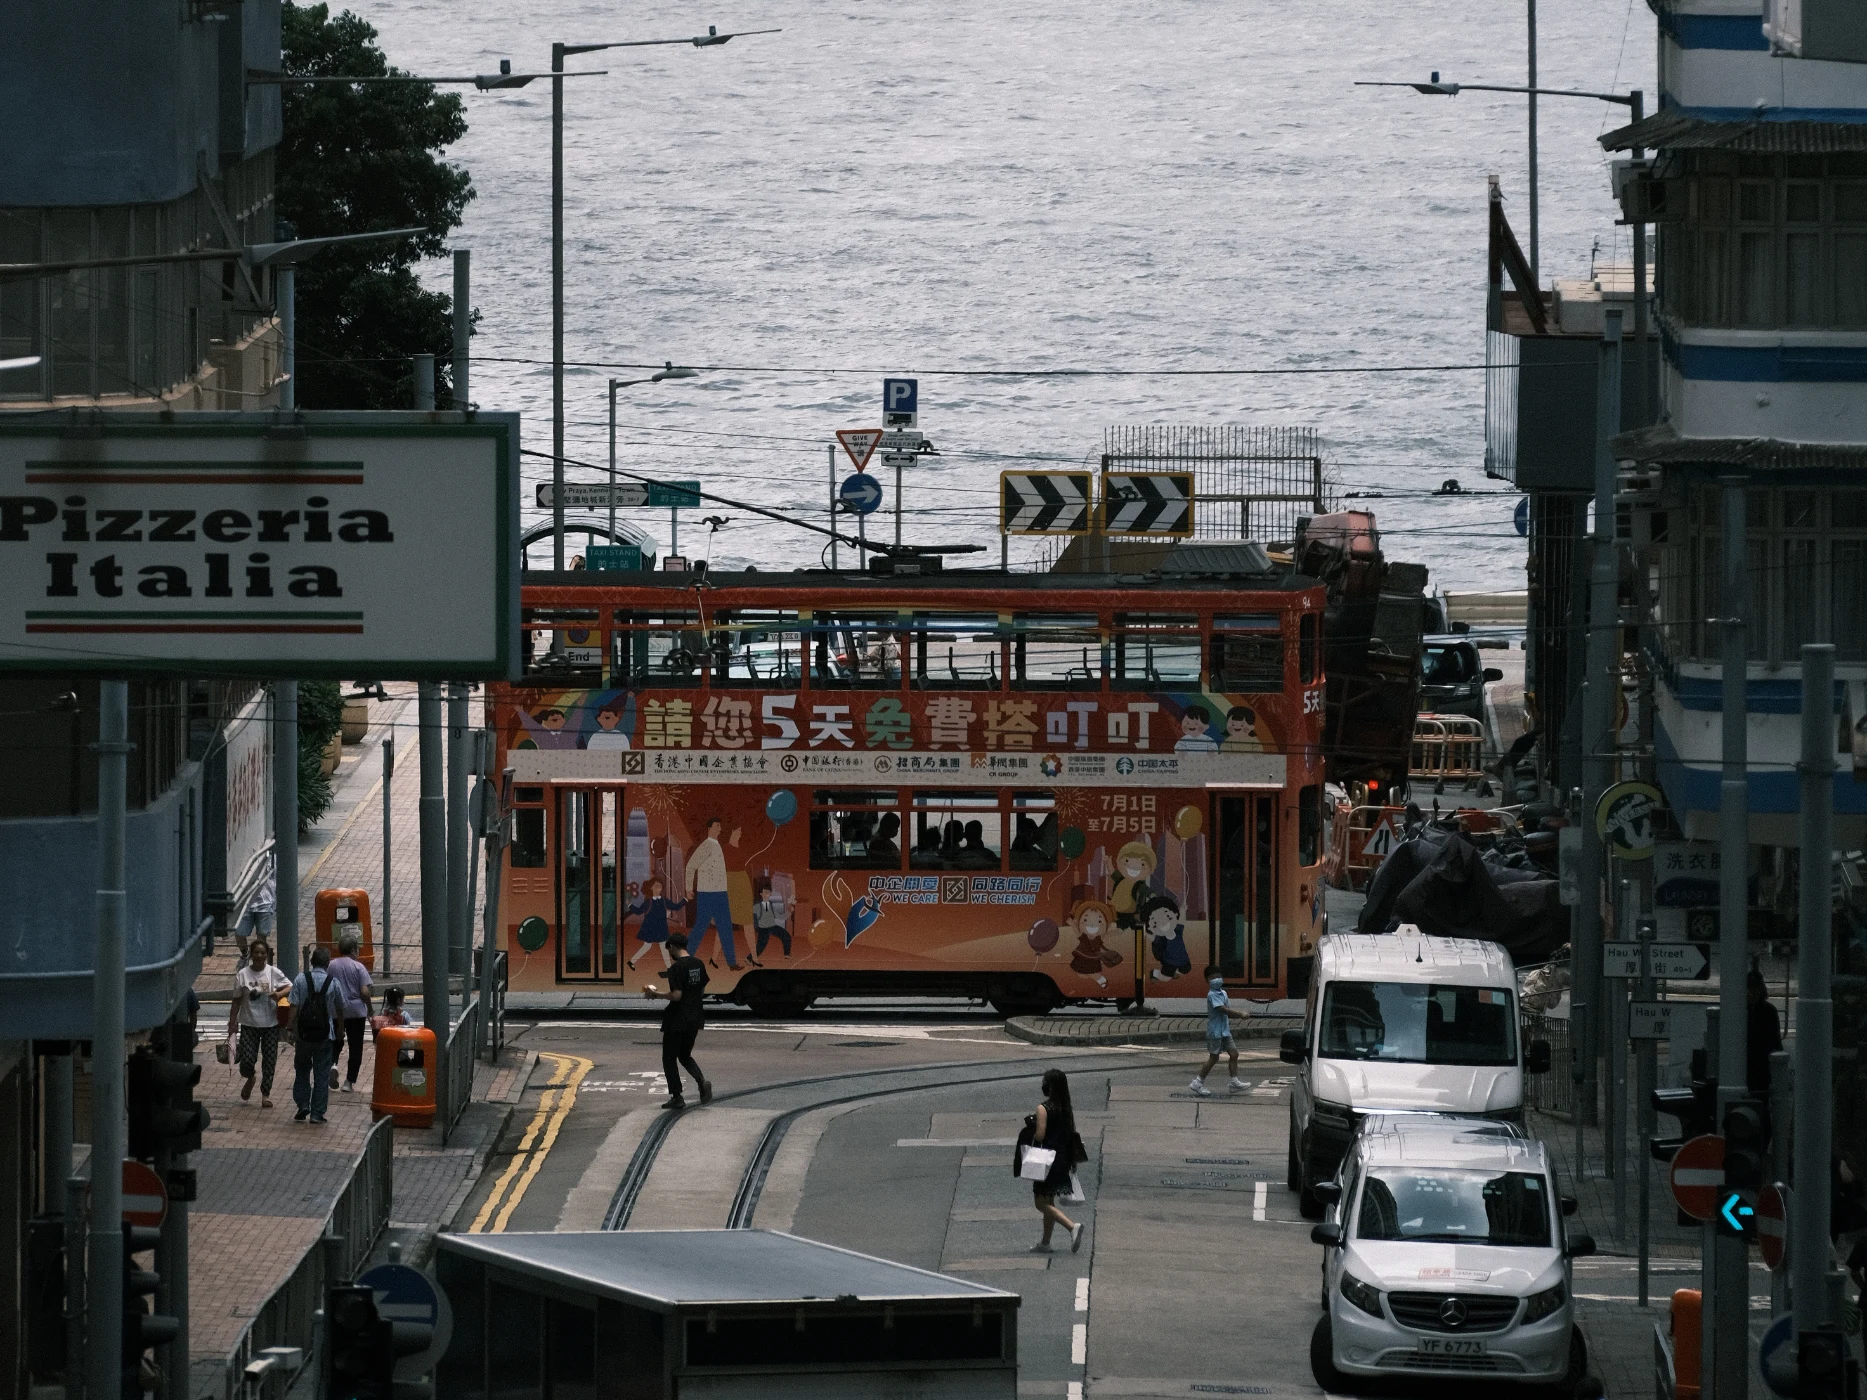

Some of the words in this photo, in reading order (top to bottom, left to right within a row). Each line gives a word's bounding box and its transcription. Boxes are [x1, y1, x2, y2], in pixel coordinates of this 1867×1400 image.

[889, 382, 912, 409] P
[0, 494, 394, 543] Pizzeria
[597, 559, 629, 569] 的士站
[46, 552, 343, 598] Italia
[568, 651, 590, 661] End
[643, 693, 1160, 751] 請您5天免費搭叮叮
[896, 756, 960, 768] 招商局集團
[1100, 794, 1156, 813] 7月1日
[1087, 816, 1156, 834] 至7月5日
[869, 876, 939, 891] 中企關愛
[971, 876, 1041, 892] 同路同行
[893, 893, 908, 904] WE
[910, 893, 939, 904] CARE
[971, 893, 988, 904] WE
[989, 893, 1036, 905] CHERISH
[1608, 948, 1628, 957] Hau
[1652, 948, 1684, 959] Street
[1625, 961, 1666, 974] 厚街
[1635, 1007, 1656, 1017] Hau
[1423, 1339, 1441, 1351] YF
[1444, 1340, 1482, 1353] 6773
